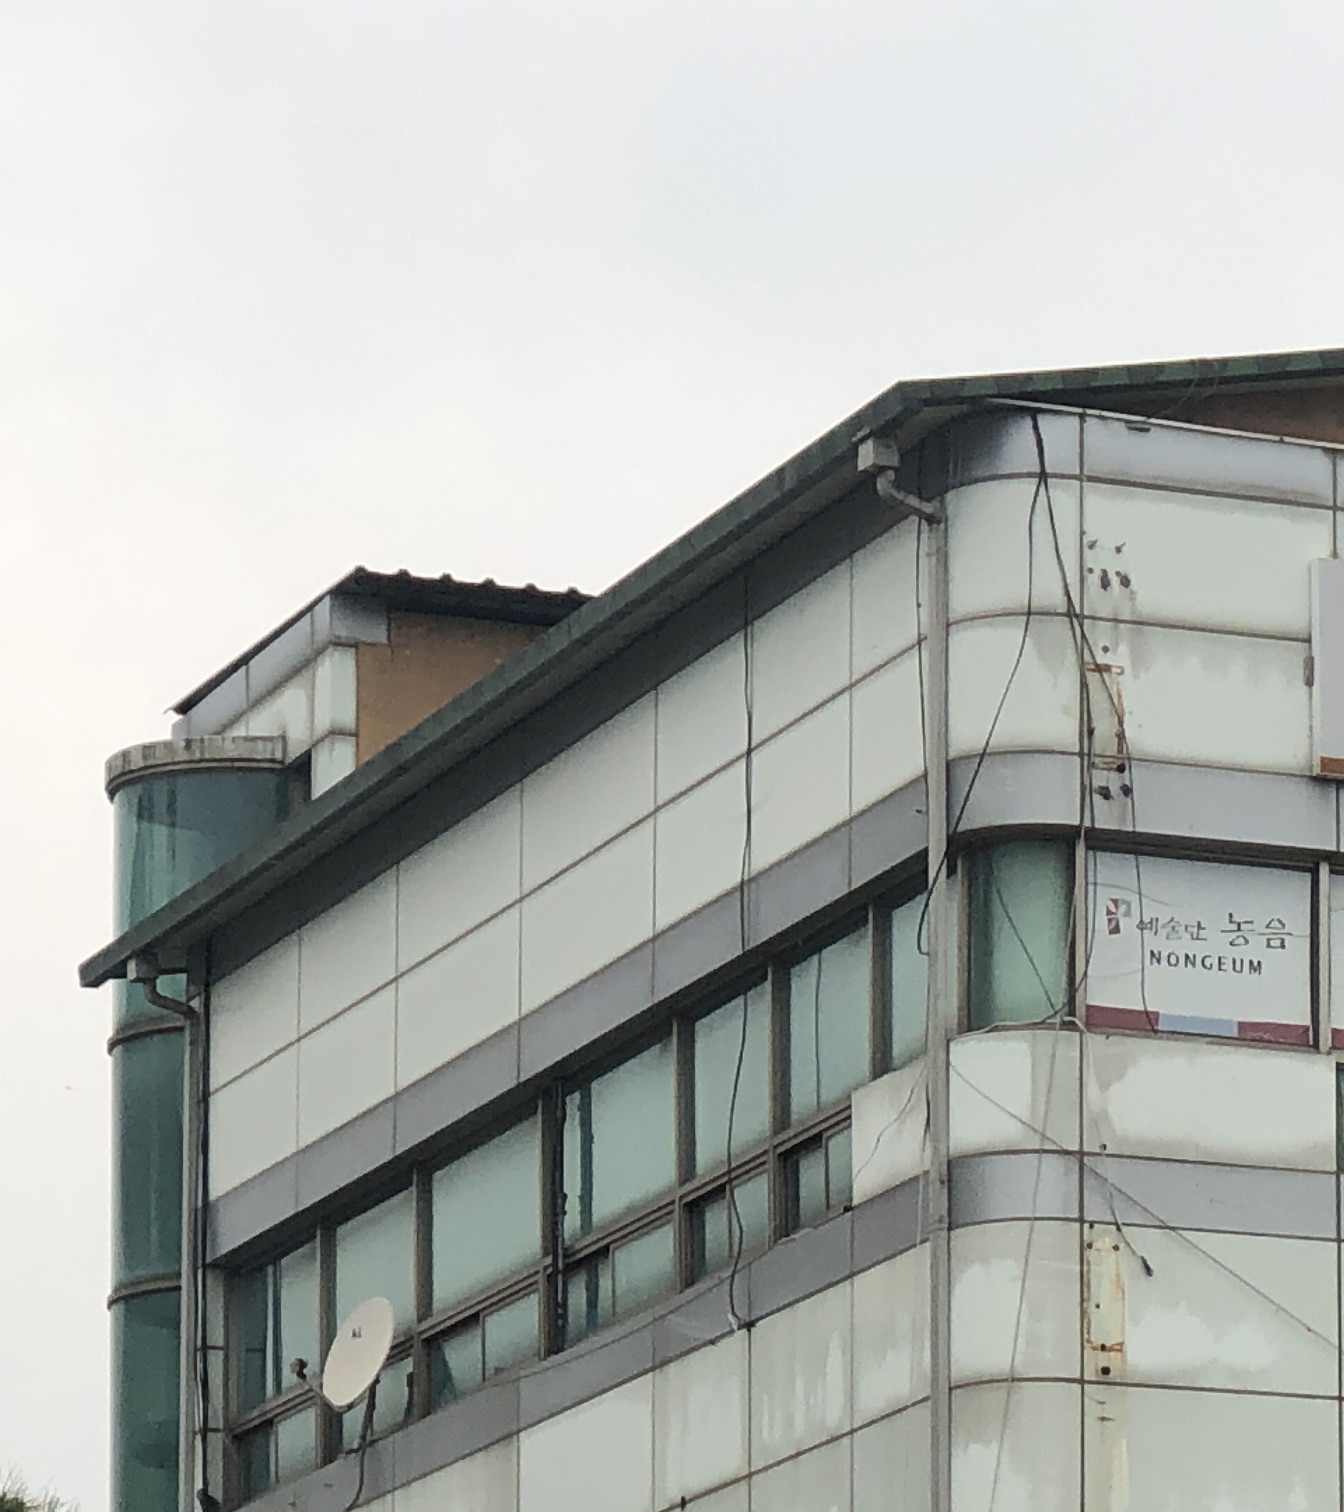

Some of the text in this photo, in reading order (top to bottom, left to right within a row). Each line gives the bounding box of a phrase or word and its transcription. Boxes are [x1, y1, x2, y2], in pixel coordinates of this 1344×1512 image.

[1136, 912, 1293, 950] 예술단 농음
[1149, 949, 1264, 976] NONGEUM
